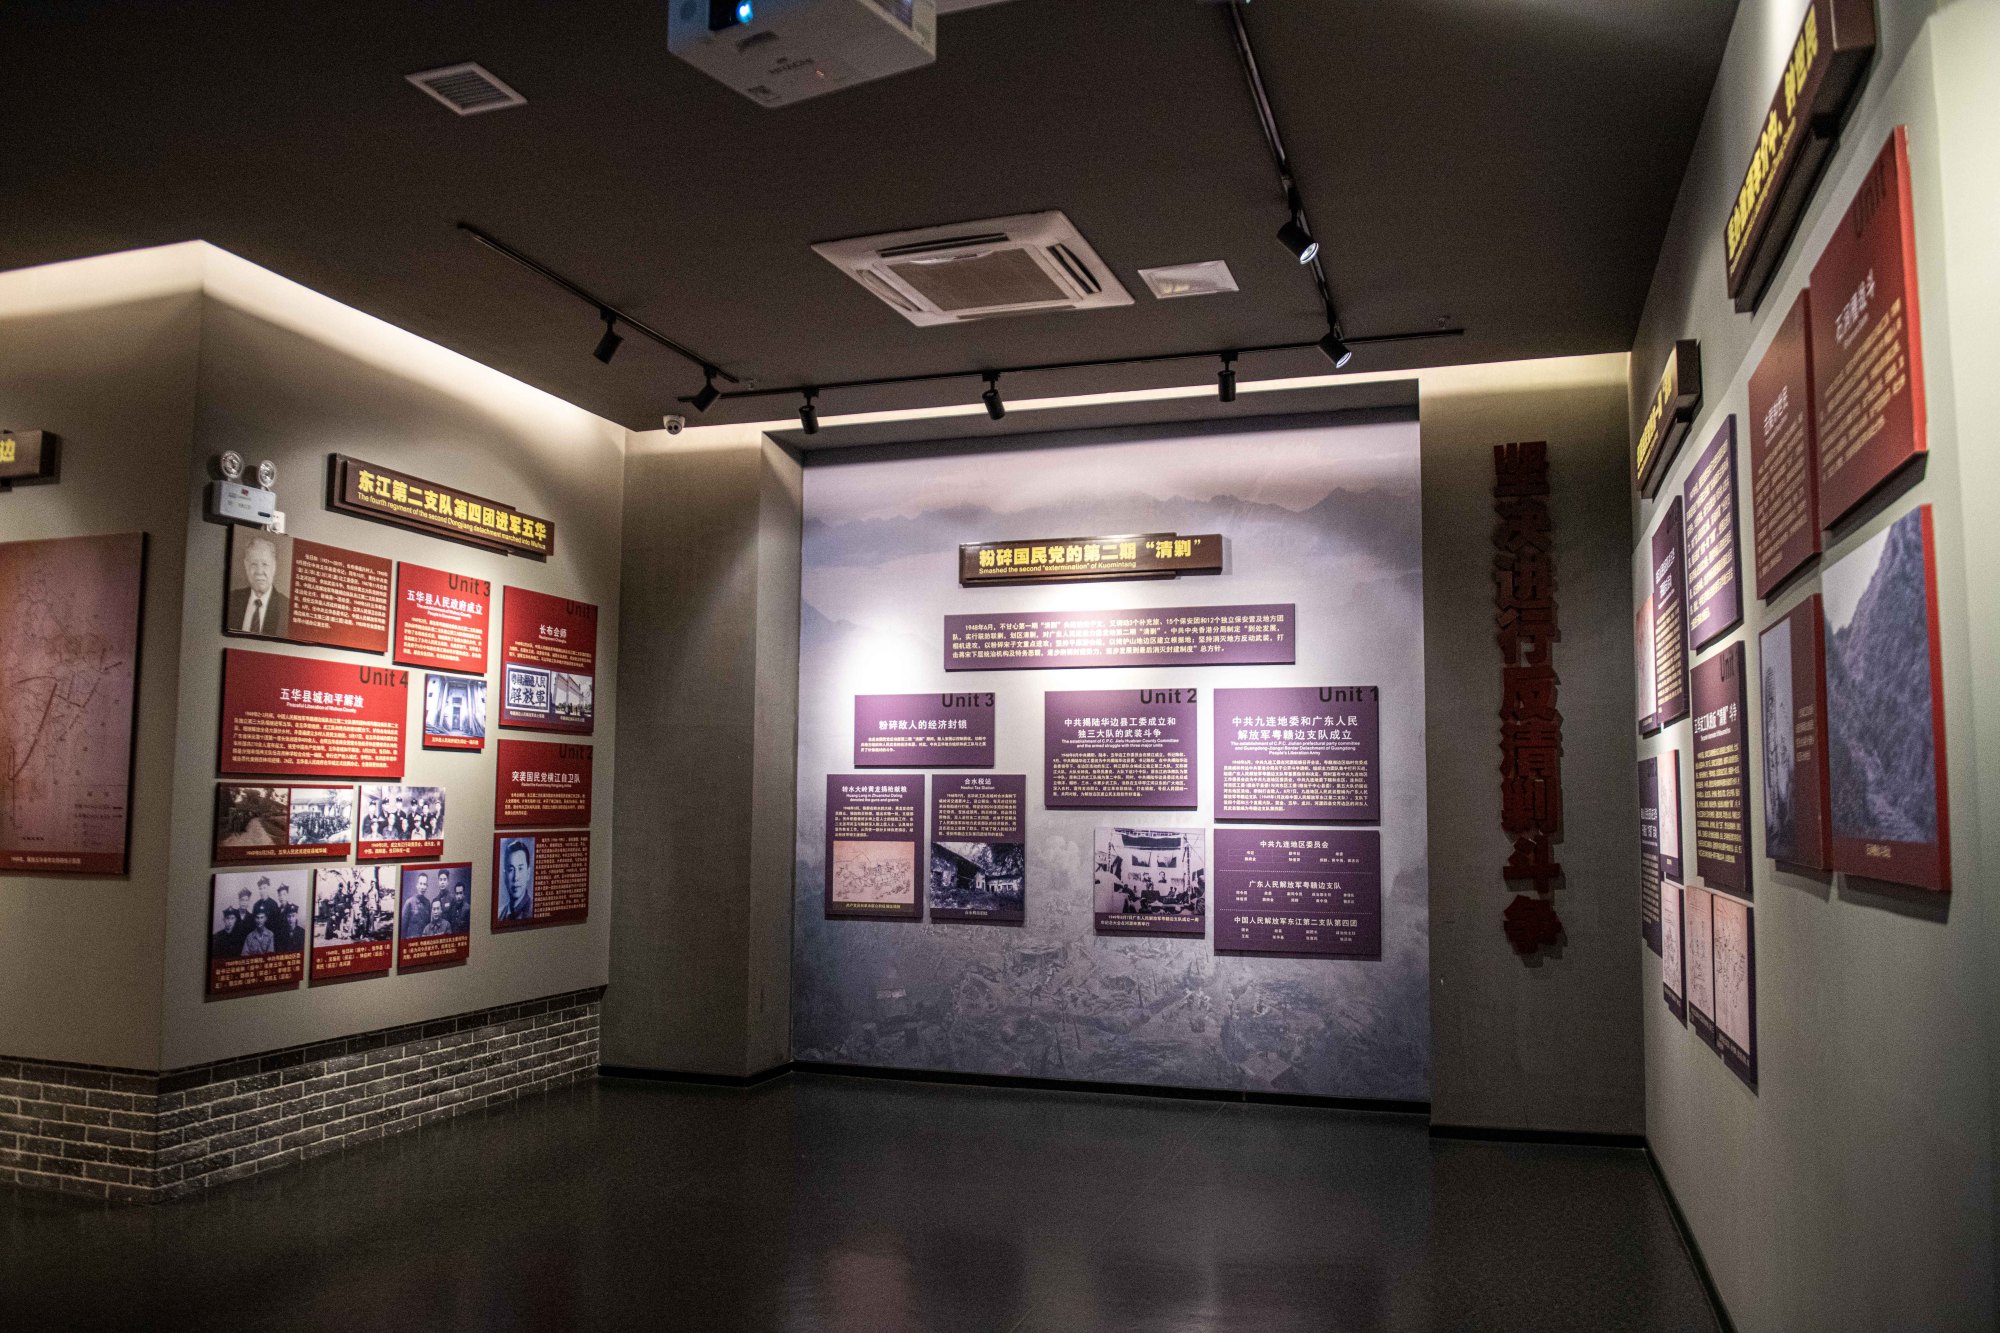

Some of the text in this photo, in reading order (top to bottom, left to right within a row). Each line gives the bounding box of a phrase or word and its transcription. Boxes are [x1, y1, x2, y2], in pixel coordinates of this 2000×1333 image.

[358, 469, 548, 541] 东江第二支队第四团进军五华
[358, 491, 369, 501] The
[370, 495, 388, 507] fourth
[413, 507, 419, 515] of
[419, 509, 428, 518] the
[428, 513, 447, 524] second
[978, 567, 1007, 575] Smashed
[1019, 565, 1042, 573] second
[1098, 560, 1137, 569] Kuomintang
[448, 572, 491, 597] Unit 3
[406, 589, 483, 615] 五华县人民政府成立
[540, 624, 567, 638] 长布会师
[359, 665, 409, 689] Unit 4
[280, 687, 365, 708] 五华县城和平解放
[942, 692, 995, 708] Unit 3
[1139, 687, 1198, 704] Unit 2
[1319, 686, 1380, 703] Unit 1
[879, 719, 968, 730] 粉碎敌人的经济封锁
[1064, 717, 1176, 727] 中共揭陆华边县工委成立和
[1232, 715, 1358, 727] 中共九连地委和广东人民
[1077, 729, 1162, 739] 独三大队的武装斗争
[1237, 729, 1353, 740] 解放军粤赣边支队成立
[512, 771, 580, 783] 突袭国民党横江自卫队
[1260, 840, 1329, 849] 中共九连地区委员会
[1248, 880, 1342, 889] 广东人民解放军粤赣边支队
[1234, 915, 1358, 927] 中国人民解放军东江第二支队第四团
